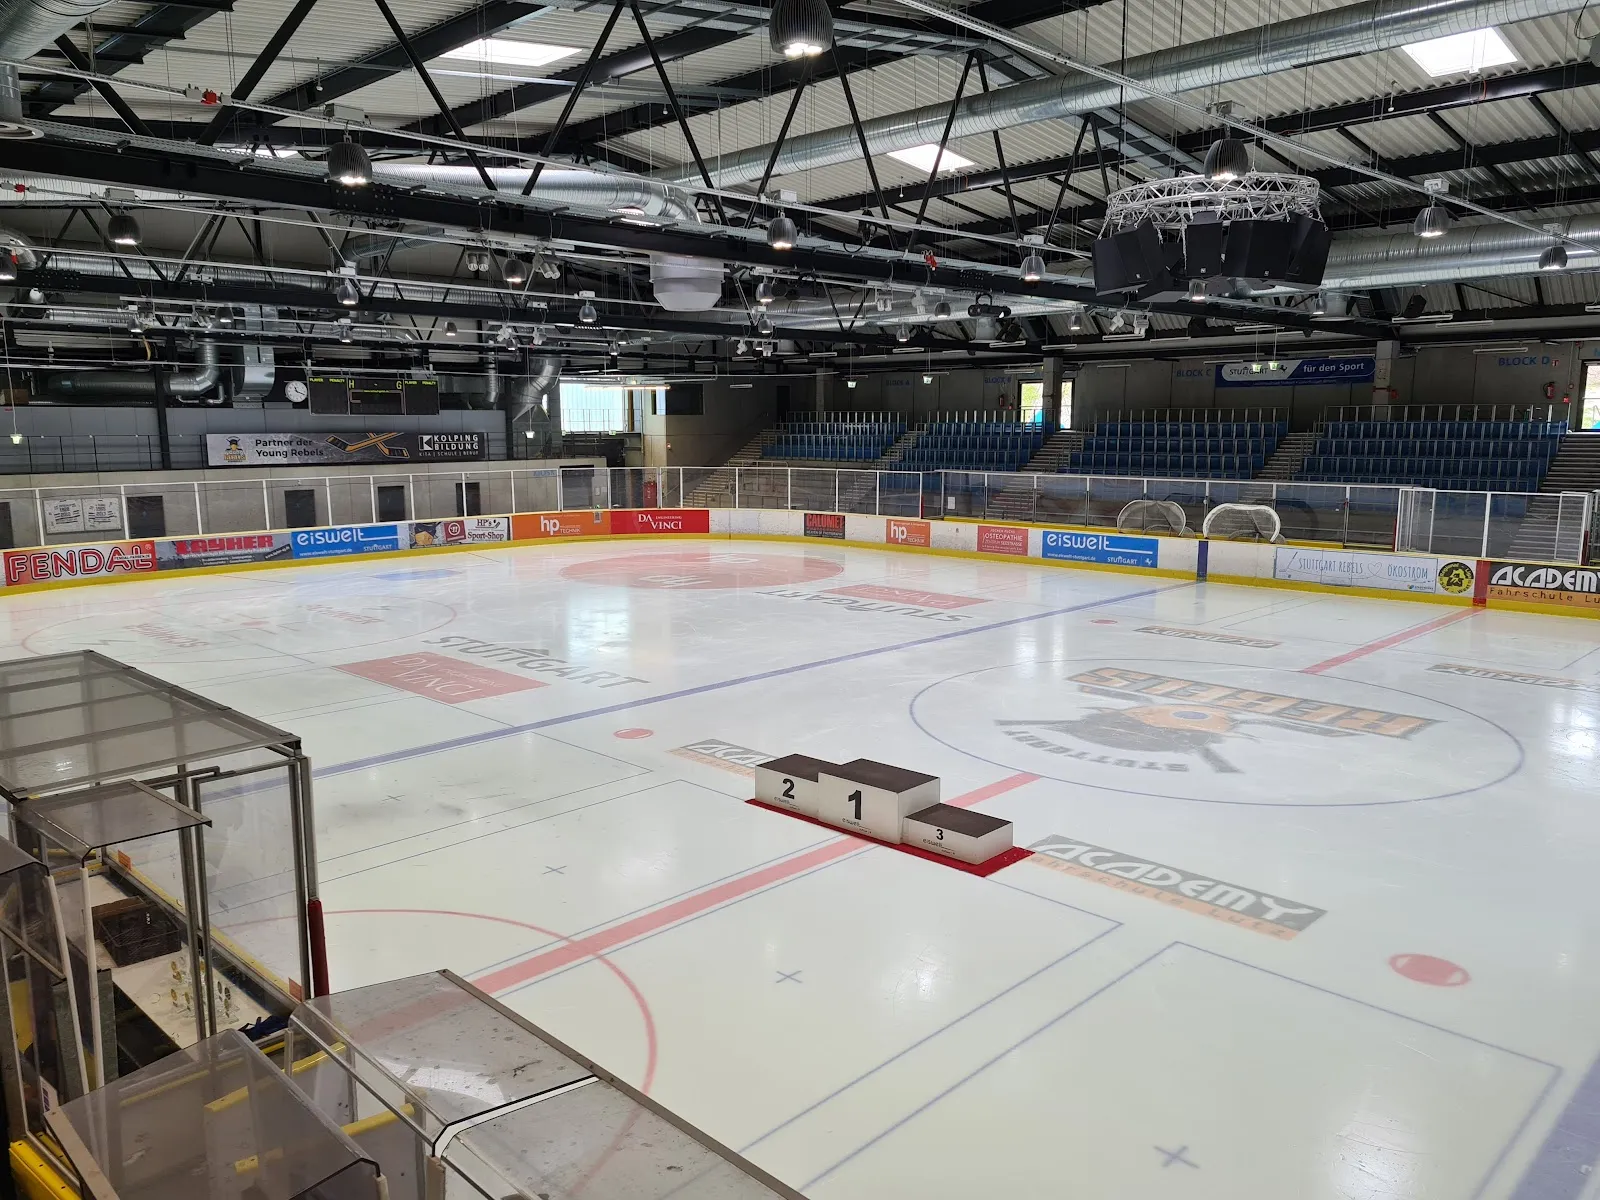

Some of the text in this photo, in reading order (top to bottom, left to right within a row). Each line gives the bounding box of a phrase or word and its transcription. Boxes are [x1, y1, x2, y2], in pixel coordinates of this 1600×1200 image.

[1304, 362, 1364, 374] für den Sport
[1499, 356, 1550, 366] BLOCK D
[1176, 369, 1202, 378] BLOCK
[348, 380, 402, 389] H G
[256, 449, 288, 458] Young
[291, 448, 324, 456] Rebels
[541, 516, 560, 535] hp
[638, 514, 652, 522] DA
[650, 521, 682, 529] VINCI
[807, 513, 844, 528] CALUMET
[297, 528, 398, 545] eiswelt
[468, 531, 504, 541] Sport-Shop
[890, 521, 907, 543] hp
[985, 533, 1023, 541] OSTEOPATHIE
[1047, 534, 1153, 554] eiswelt
[9, 546, 153, 582] FENDAL
[1107, 556, 1138, 565] STUTTGART
[1299, 558, 1428, 579] STUTTGART REBELS ÖKOSTROM
[1490, 587, 1573, 602] Fahrschule
[422, 634, 652, 688] STUTTGART
[398, 664, 482, 697] VINCI
[782, 778, 795, 800] 2
[848, 790, 862, 820] 1
[936, 829, 944, 841] 3
[1034, 843, 1316, 920] ACADEMY
[1208, 907, 1286, 937] Lutz
